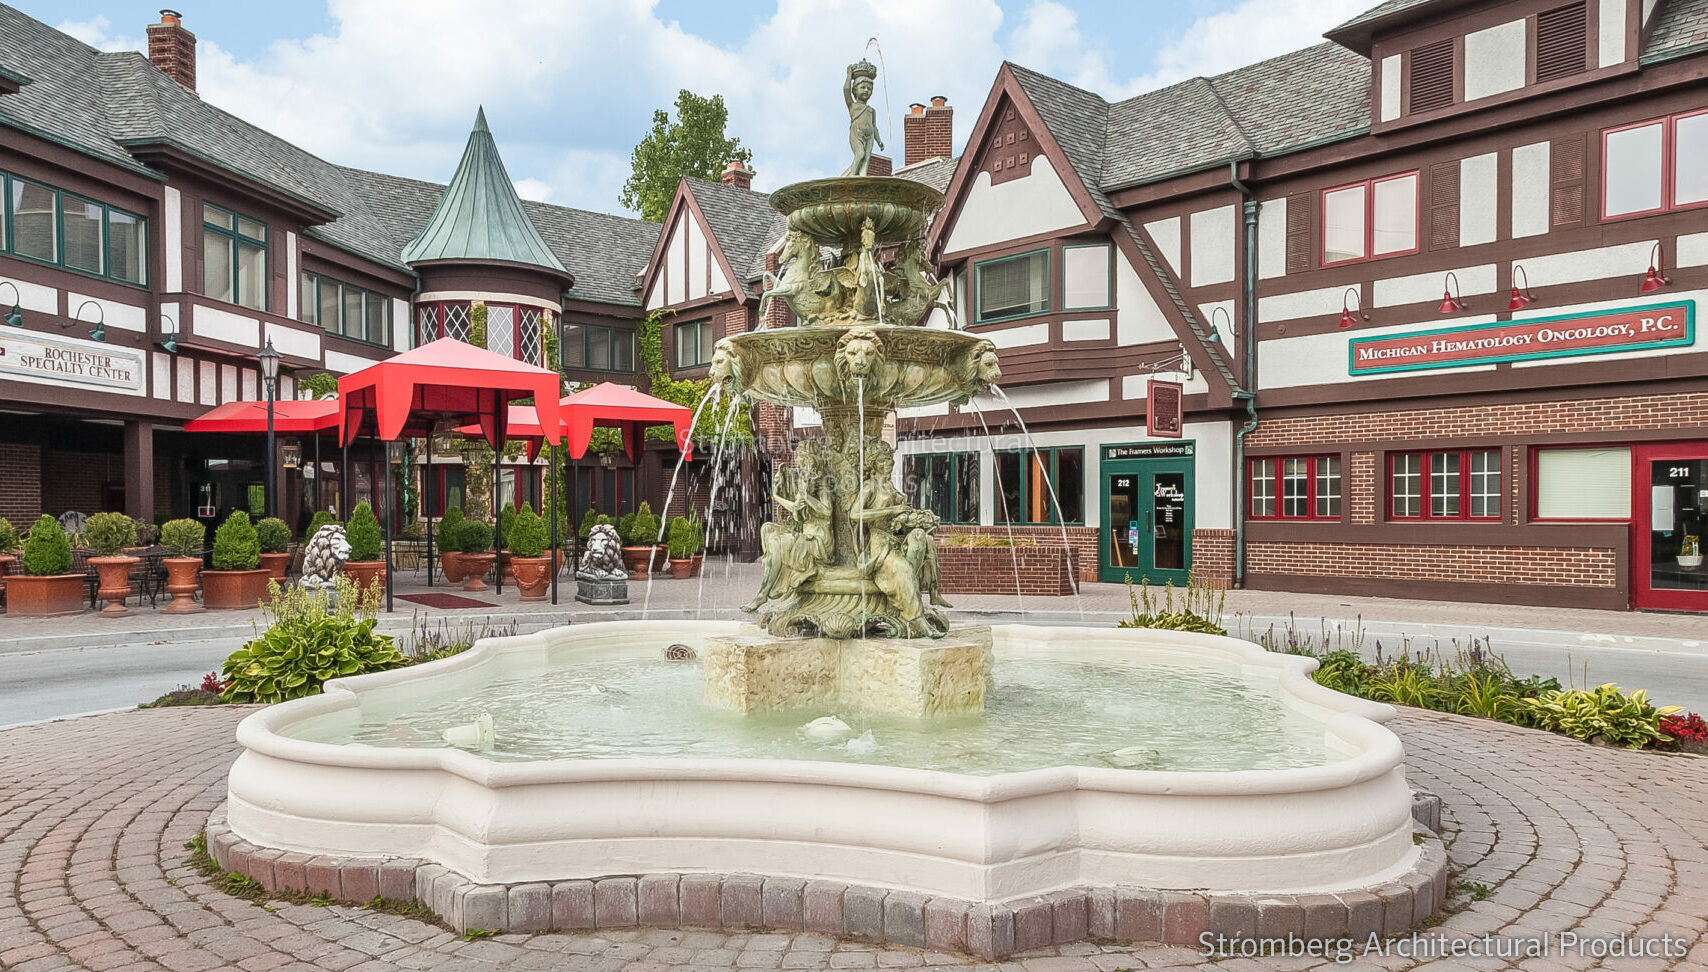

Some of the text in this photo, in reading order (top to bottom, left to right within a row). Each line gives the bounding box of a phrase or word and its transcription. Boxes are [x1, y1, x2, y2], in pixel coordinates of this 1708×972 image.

[1358, 315, 1679, 361] Michigan Hematology Oncology, P.C.
[45, 347, 111, 367] ROCHESTER
[20, 355, 131, 381] SPECIALTY CENTER
[1117, 446, 1184, 456] The Framers Workshop
[1669, 467, 1689, 477] 211
